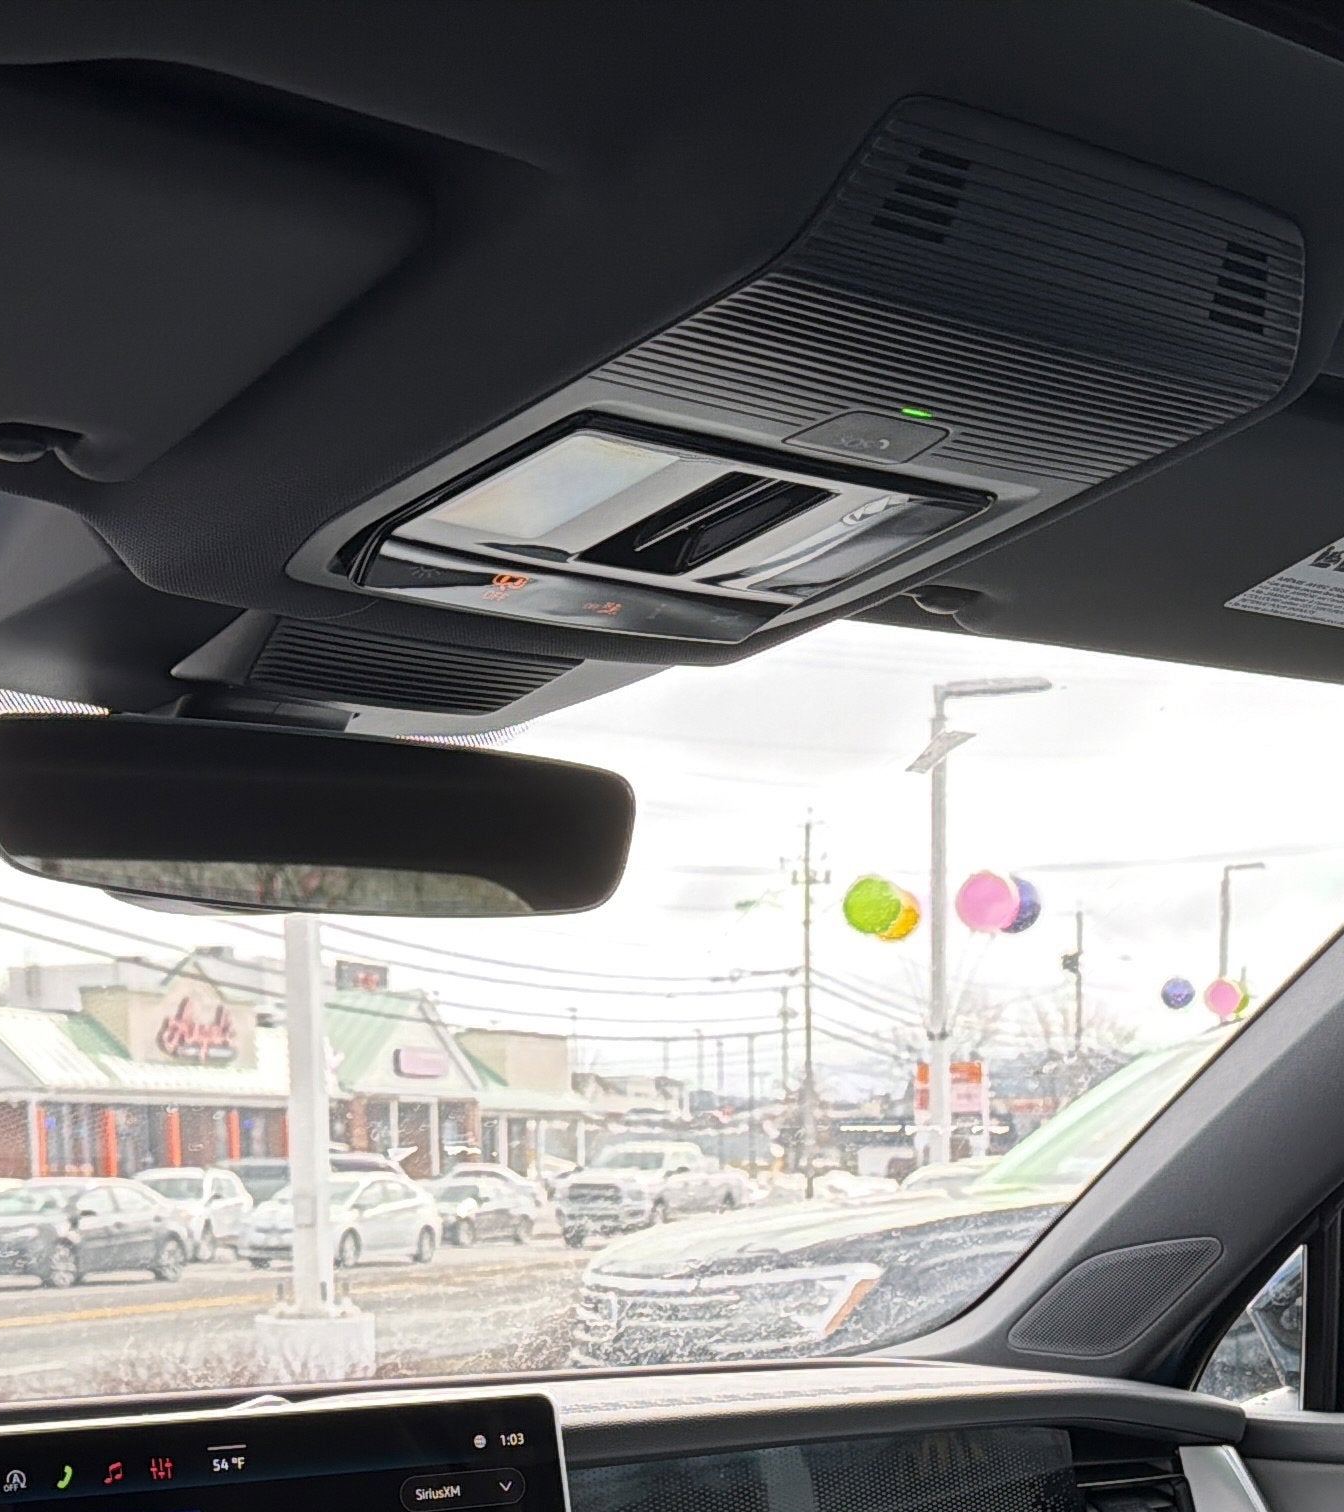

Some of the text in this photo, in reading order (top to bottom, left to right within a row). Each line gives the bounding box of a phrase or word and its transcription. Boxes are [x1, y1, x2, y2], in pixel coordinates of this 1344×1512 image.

[500, 1433, 525, 1446] 1:03
[213, 1458, 229, 1471] 54
[415, 1485, 461, 1501] SiriusXM
